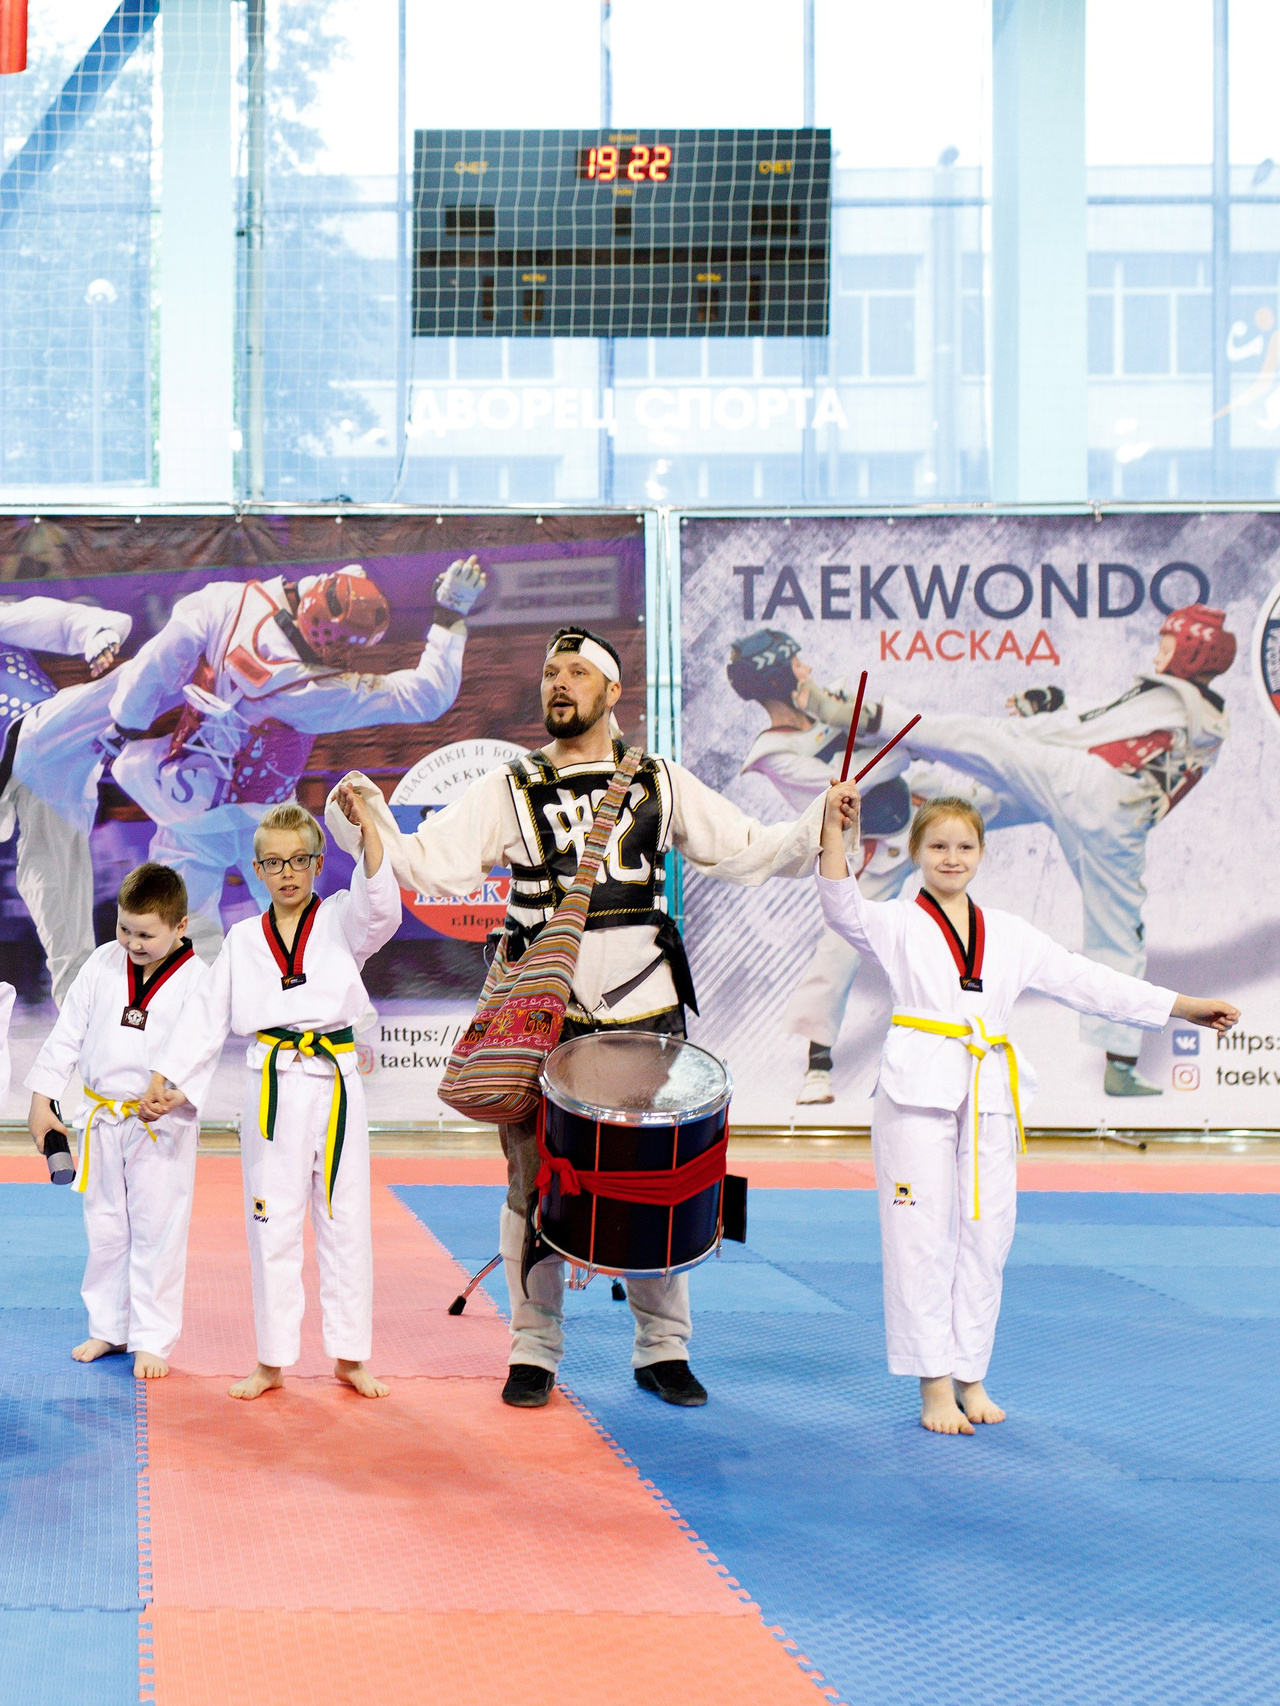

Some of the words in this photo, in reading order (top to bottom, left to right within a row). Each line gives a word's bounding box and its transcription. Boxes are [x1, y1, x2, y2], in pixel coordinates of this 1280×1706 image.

[587, 145, 618, 181] 19
[627, 145, 671, 181] 22
[411, 388, 617, 437] ДВОРЕЦ
[634, 388, 849, 430] СПОРТА
[733, 562, 1211, 620] TAEKWONDO
[880, 629, 1060, 667] КАСКАД
[475, 746, 484, 756] И
[381, 1026, 466, 1046] https://
